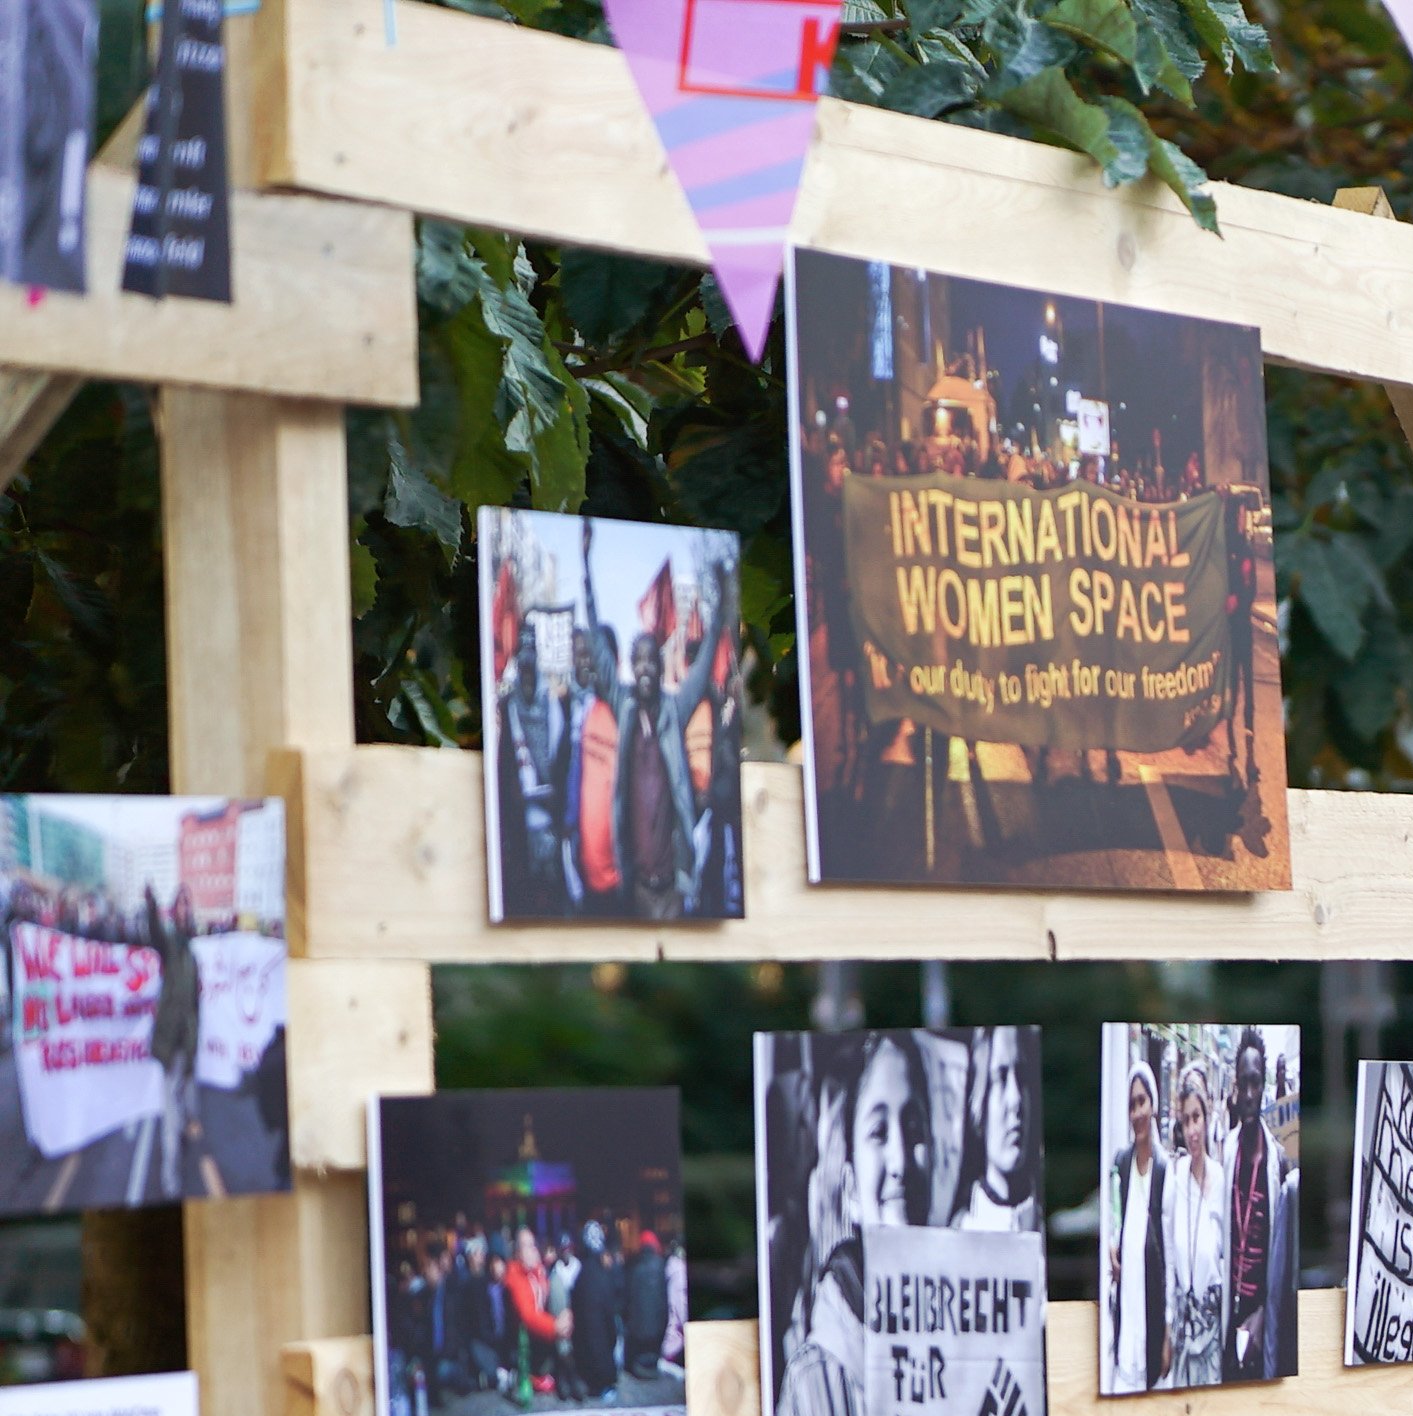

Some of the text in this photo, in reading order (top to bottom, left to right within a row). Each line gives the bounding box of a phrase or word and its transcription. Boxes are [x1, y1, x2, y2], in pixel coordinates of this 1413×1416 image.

[890, 489, 1189, 567] INTERNATIONAL
[897, 565, 1189, 647] WOMEN SPACE
[910, 665, 947, 694] our
[998, 672, 1021, 704] to
[1072, 659, 1100, 696] for
[1105, 669, 1136, 698] our
